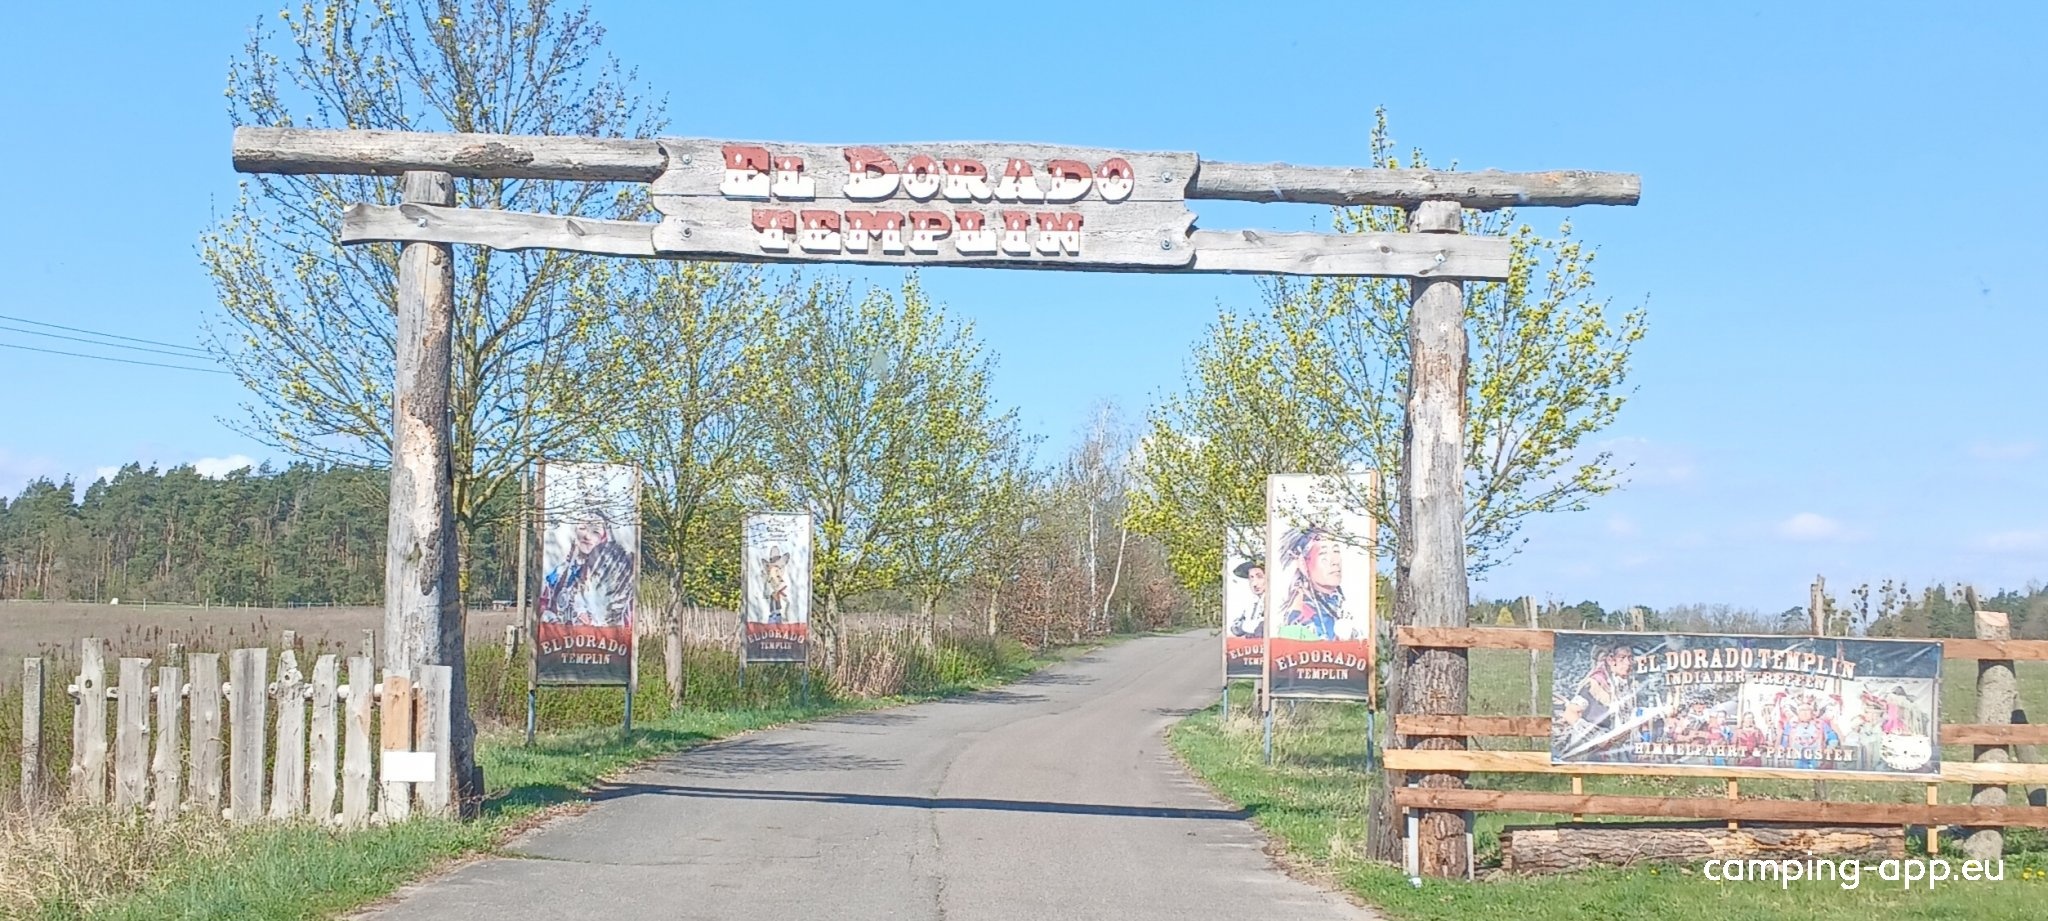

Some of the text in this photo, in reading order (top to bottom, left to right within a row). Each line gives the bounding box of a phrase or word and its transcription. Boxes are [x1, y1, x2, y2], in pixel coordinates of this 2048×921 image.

[842, 147, 1134, 202] DORADO
[752, 208, 1084, 257] TEMPLIN
[561, 652, 612, 665] TEMPLIN
[1636, 647, 1857, 678] EL DORADO TEMPLIN
[1296, 668, 1349, 680] TEMPLIN
[1665, 670, 1828, 690] INDIANER TREFFEN
[1752, 748, 1761, 758] &
